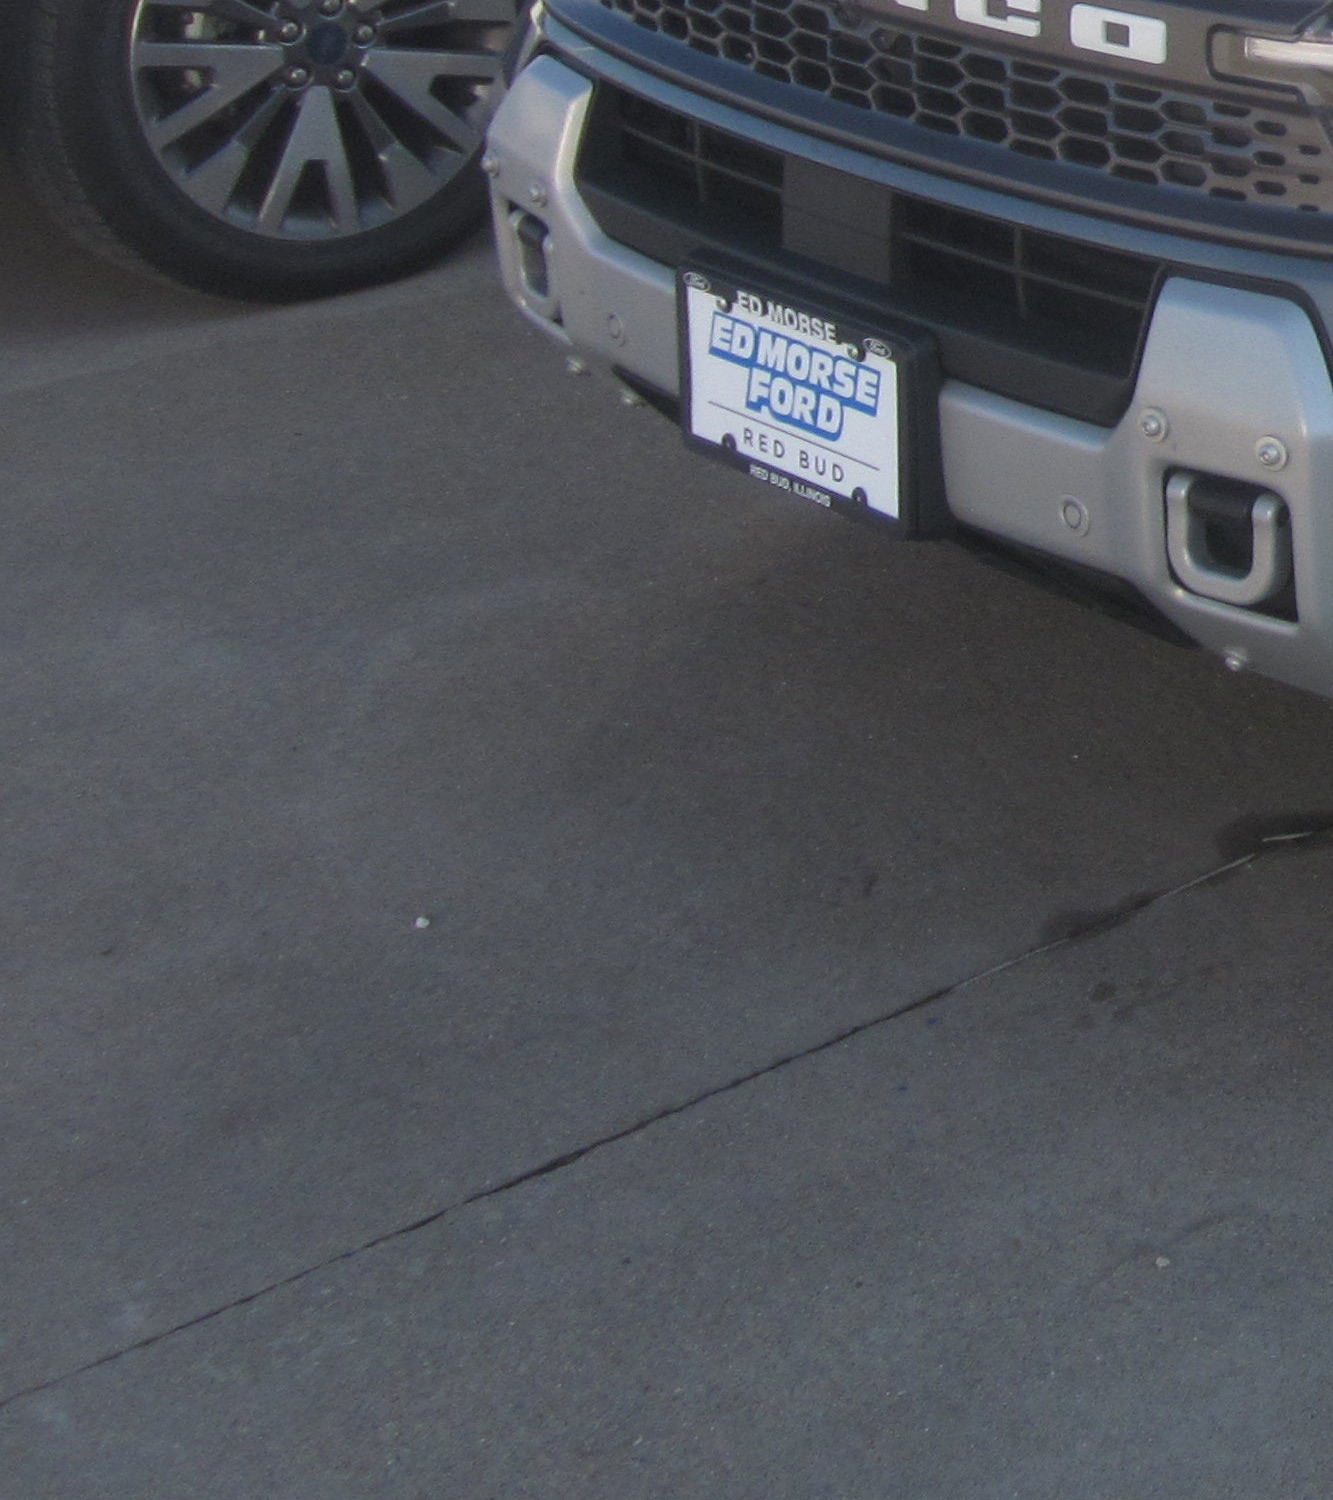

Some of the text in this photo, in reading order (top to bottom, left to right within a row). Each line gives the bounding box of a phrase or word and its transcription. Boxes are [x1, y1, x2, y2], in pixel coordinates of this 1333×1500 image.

[737, 290, 837, 344] ED MORSE
[710, 313, 879, 414] ED MORSE
[747, 367, 843, 437] FORD
[743, 427, 845, 483] RED BUD
